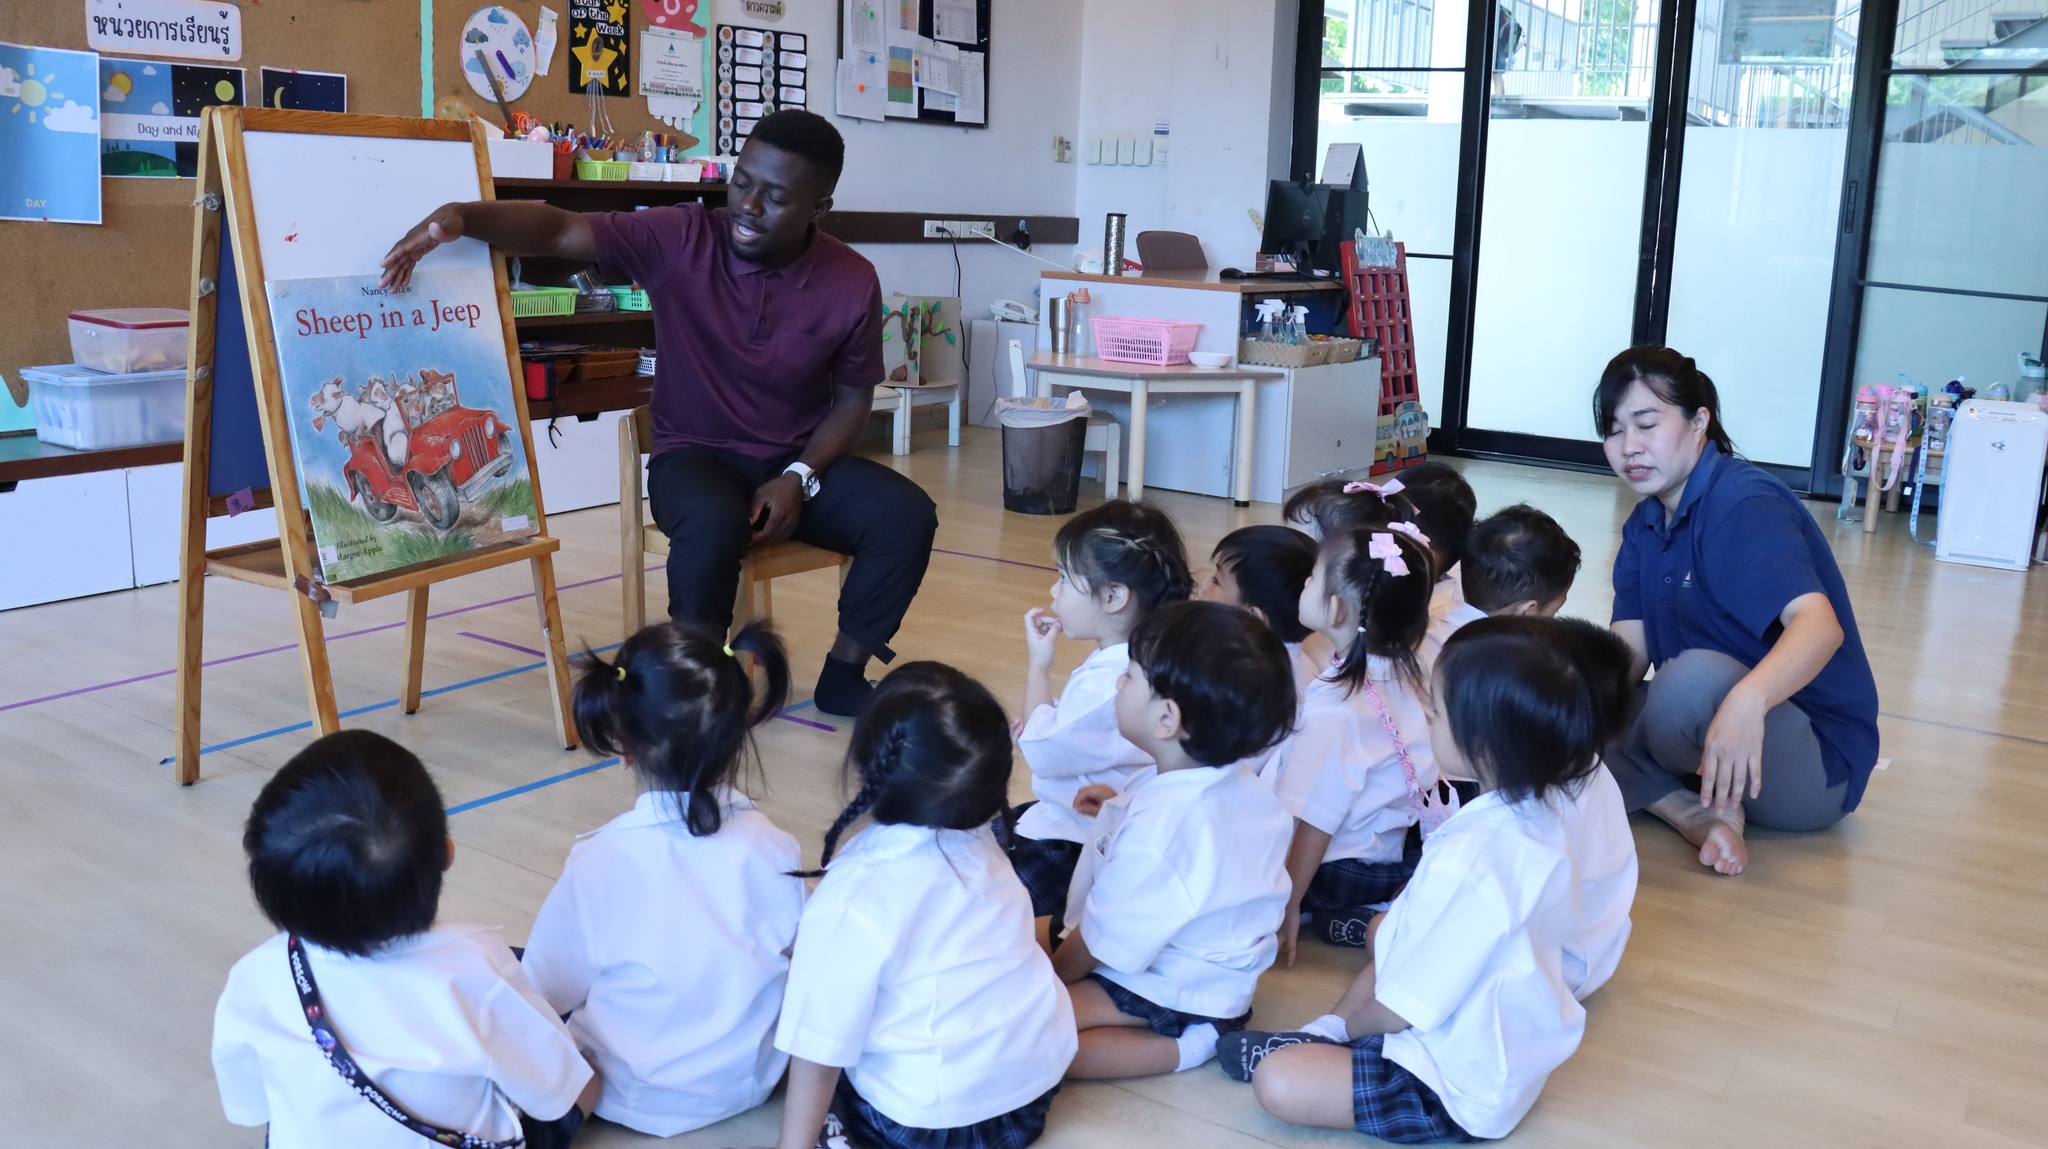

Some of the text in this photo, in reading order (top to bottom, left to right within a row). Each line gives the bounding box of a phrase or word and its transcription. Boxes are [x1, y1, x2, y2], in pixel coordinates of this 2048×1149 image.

[572, 8, 608, 20] of the
[93, 3, 230, 54] หน่วยการเรียนรู้
[597, 23, 624, 35] Week
[138, 123, 159, 137] Day
[163, 125, 182, 136] and
[25, 198, 47, 208] DAY
[361, 286, 388, 297] Nancy
[296, 300, 481, 338] Sheep in a Jeep
[336, 534, 377, 550] Illustrated by
[363, 544, 383, 556] Apple
